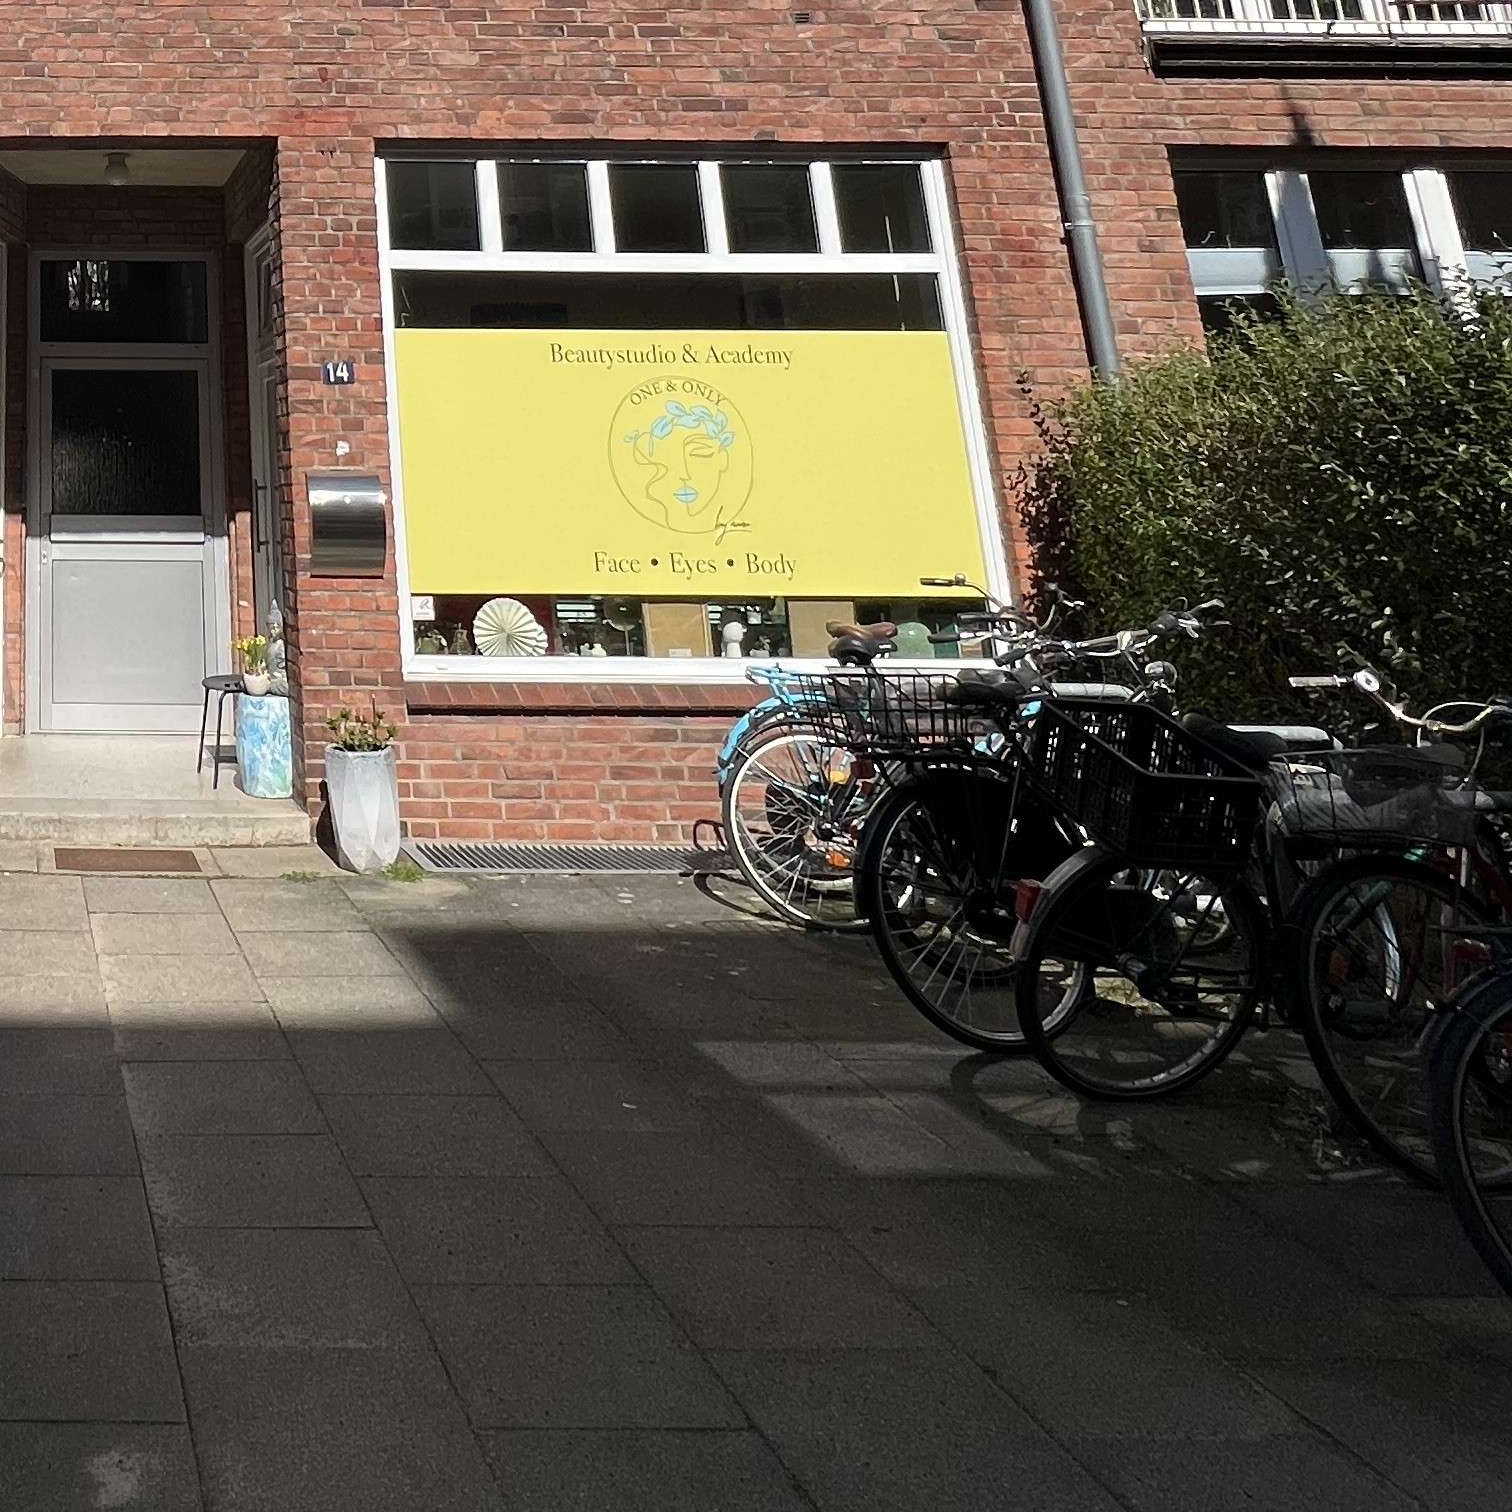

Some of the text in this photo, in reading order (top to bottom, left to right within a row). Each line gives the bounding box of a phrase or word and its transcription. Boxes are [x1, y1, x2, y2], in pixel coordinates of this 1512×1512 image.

[550, 343, 792, 370] Beautystudio & Academy
[326, 361, 349, 382] 14
[630, 380, 726, 406] ONE & ONLY
[594, 551, 797, 581] Face Eyes Body
